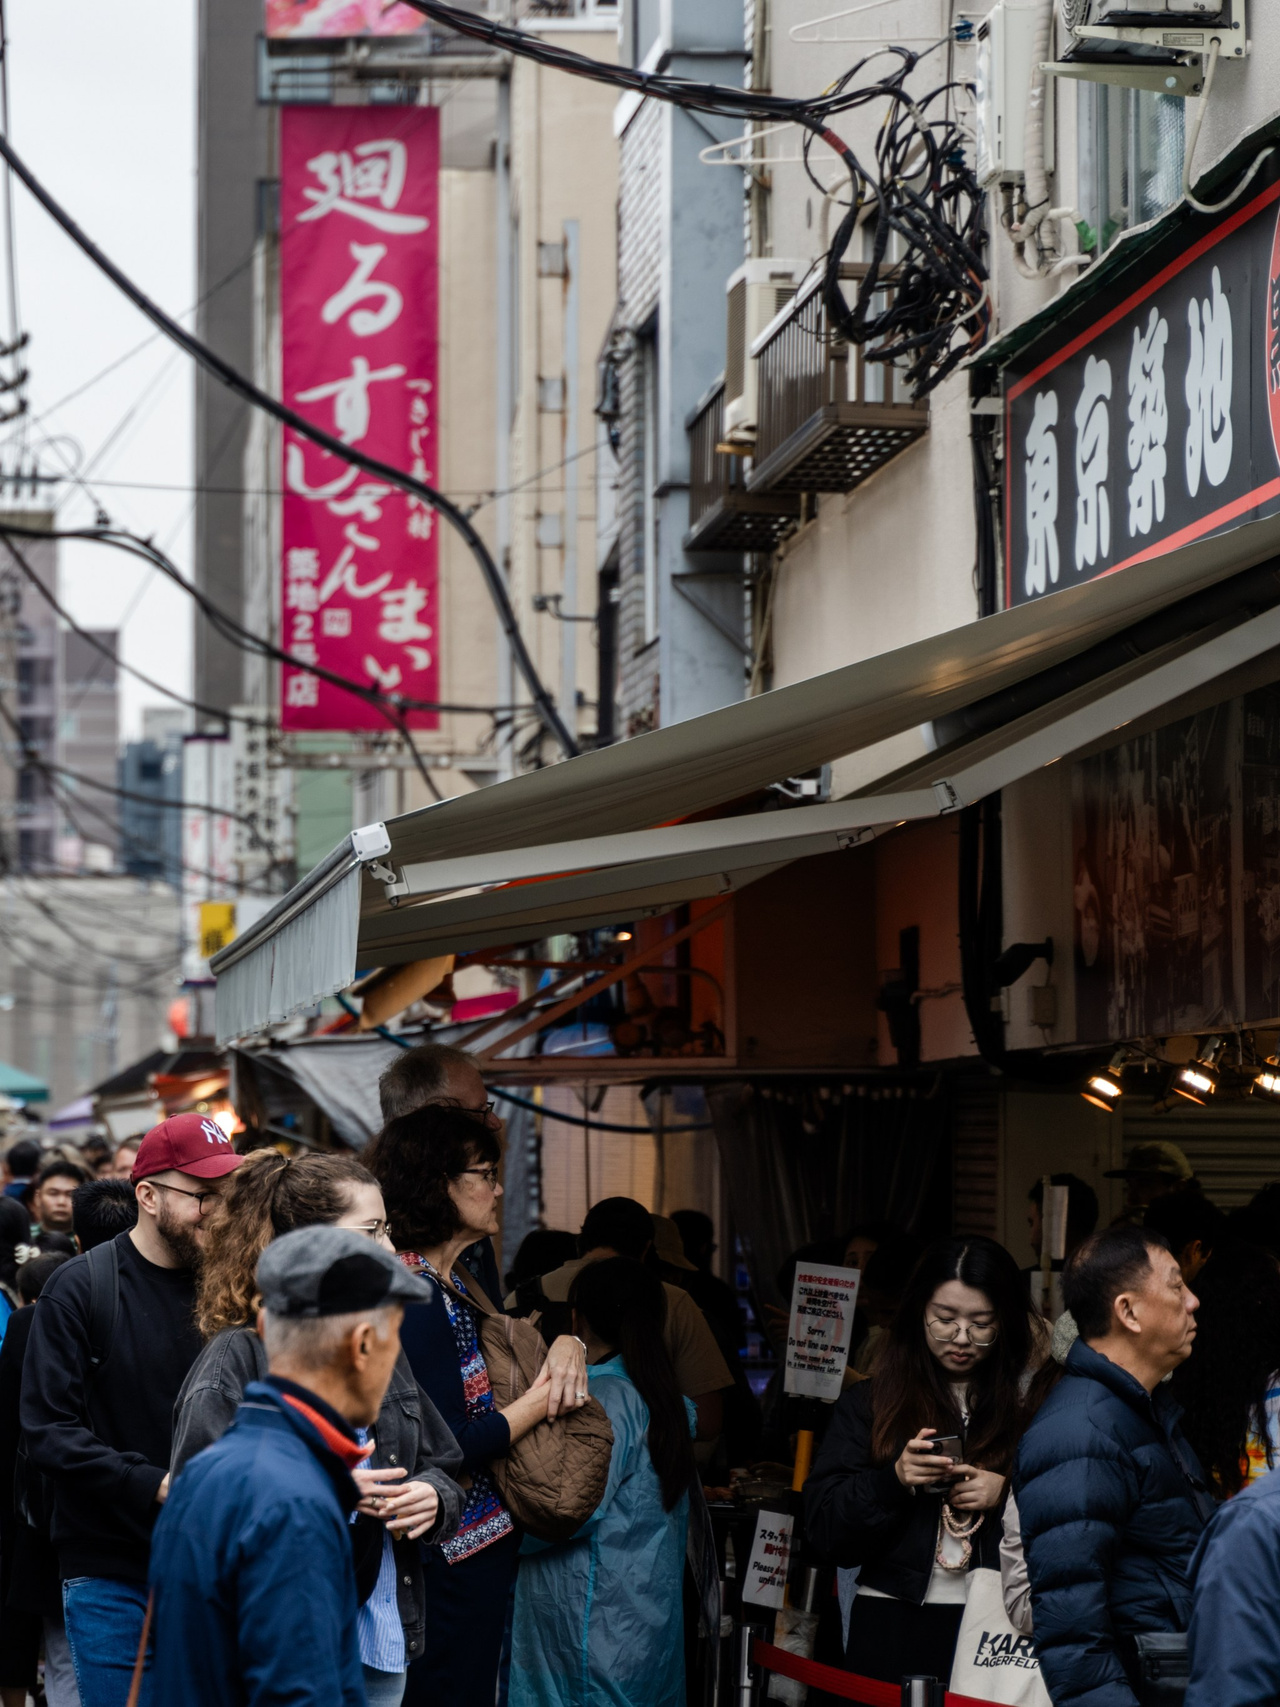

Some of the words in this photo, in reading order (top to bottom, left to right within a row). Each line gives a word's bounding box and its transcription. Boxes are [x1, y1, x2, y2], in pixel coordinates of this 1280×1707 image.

[1025, 265, 1233, 597] 東京築地
[200, 1119, 229, 1144] NY
[788, 1337, 796, 1346] Do
[796, 1339, 807, 1348] not
[808, 1340, 819, 1349] line
[820, 1343, 829, 1352] up
[793, 1352, 808, 1361] Please
[822, 1356, 836, 1365] back
[807, 1363, 826, 1373] minutes
[752, 1561, 775, 1574] Please
[758, 1576, 777, 1586] until
[973, 1654, 1040, 1670] LAGERFELD
